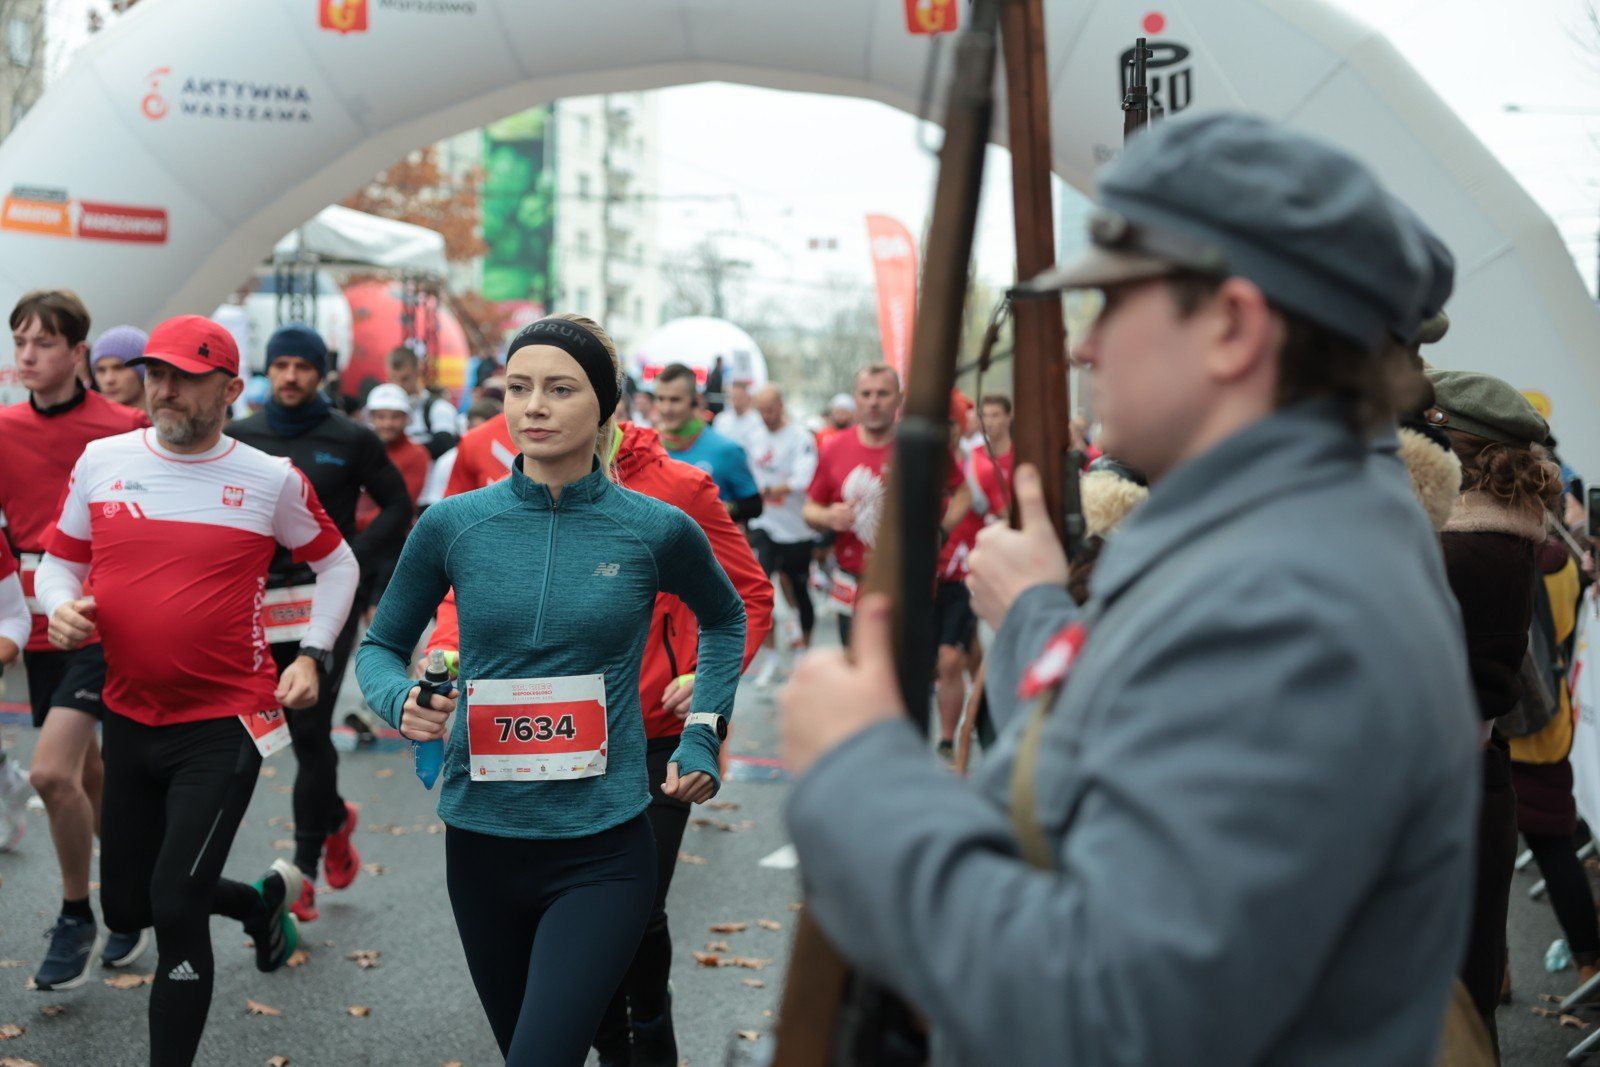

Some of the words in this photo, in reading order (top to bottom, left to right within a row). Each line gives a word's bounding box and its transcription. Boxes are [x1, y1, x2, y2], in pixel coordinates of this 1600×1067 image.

[180, 77, 312, 104] AKTYWNA
[181, 101, 313, 124] WARSZAWA
[494, 714, 576, 742] 7634
